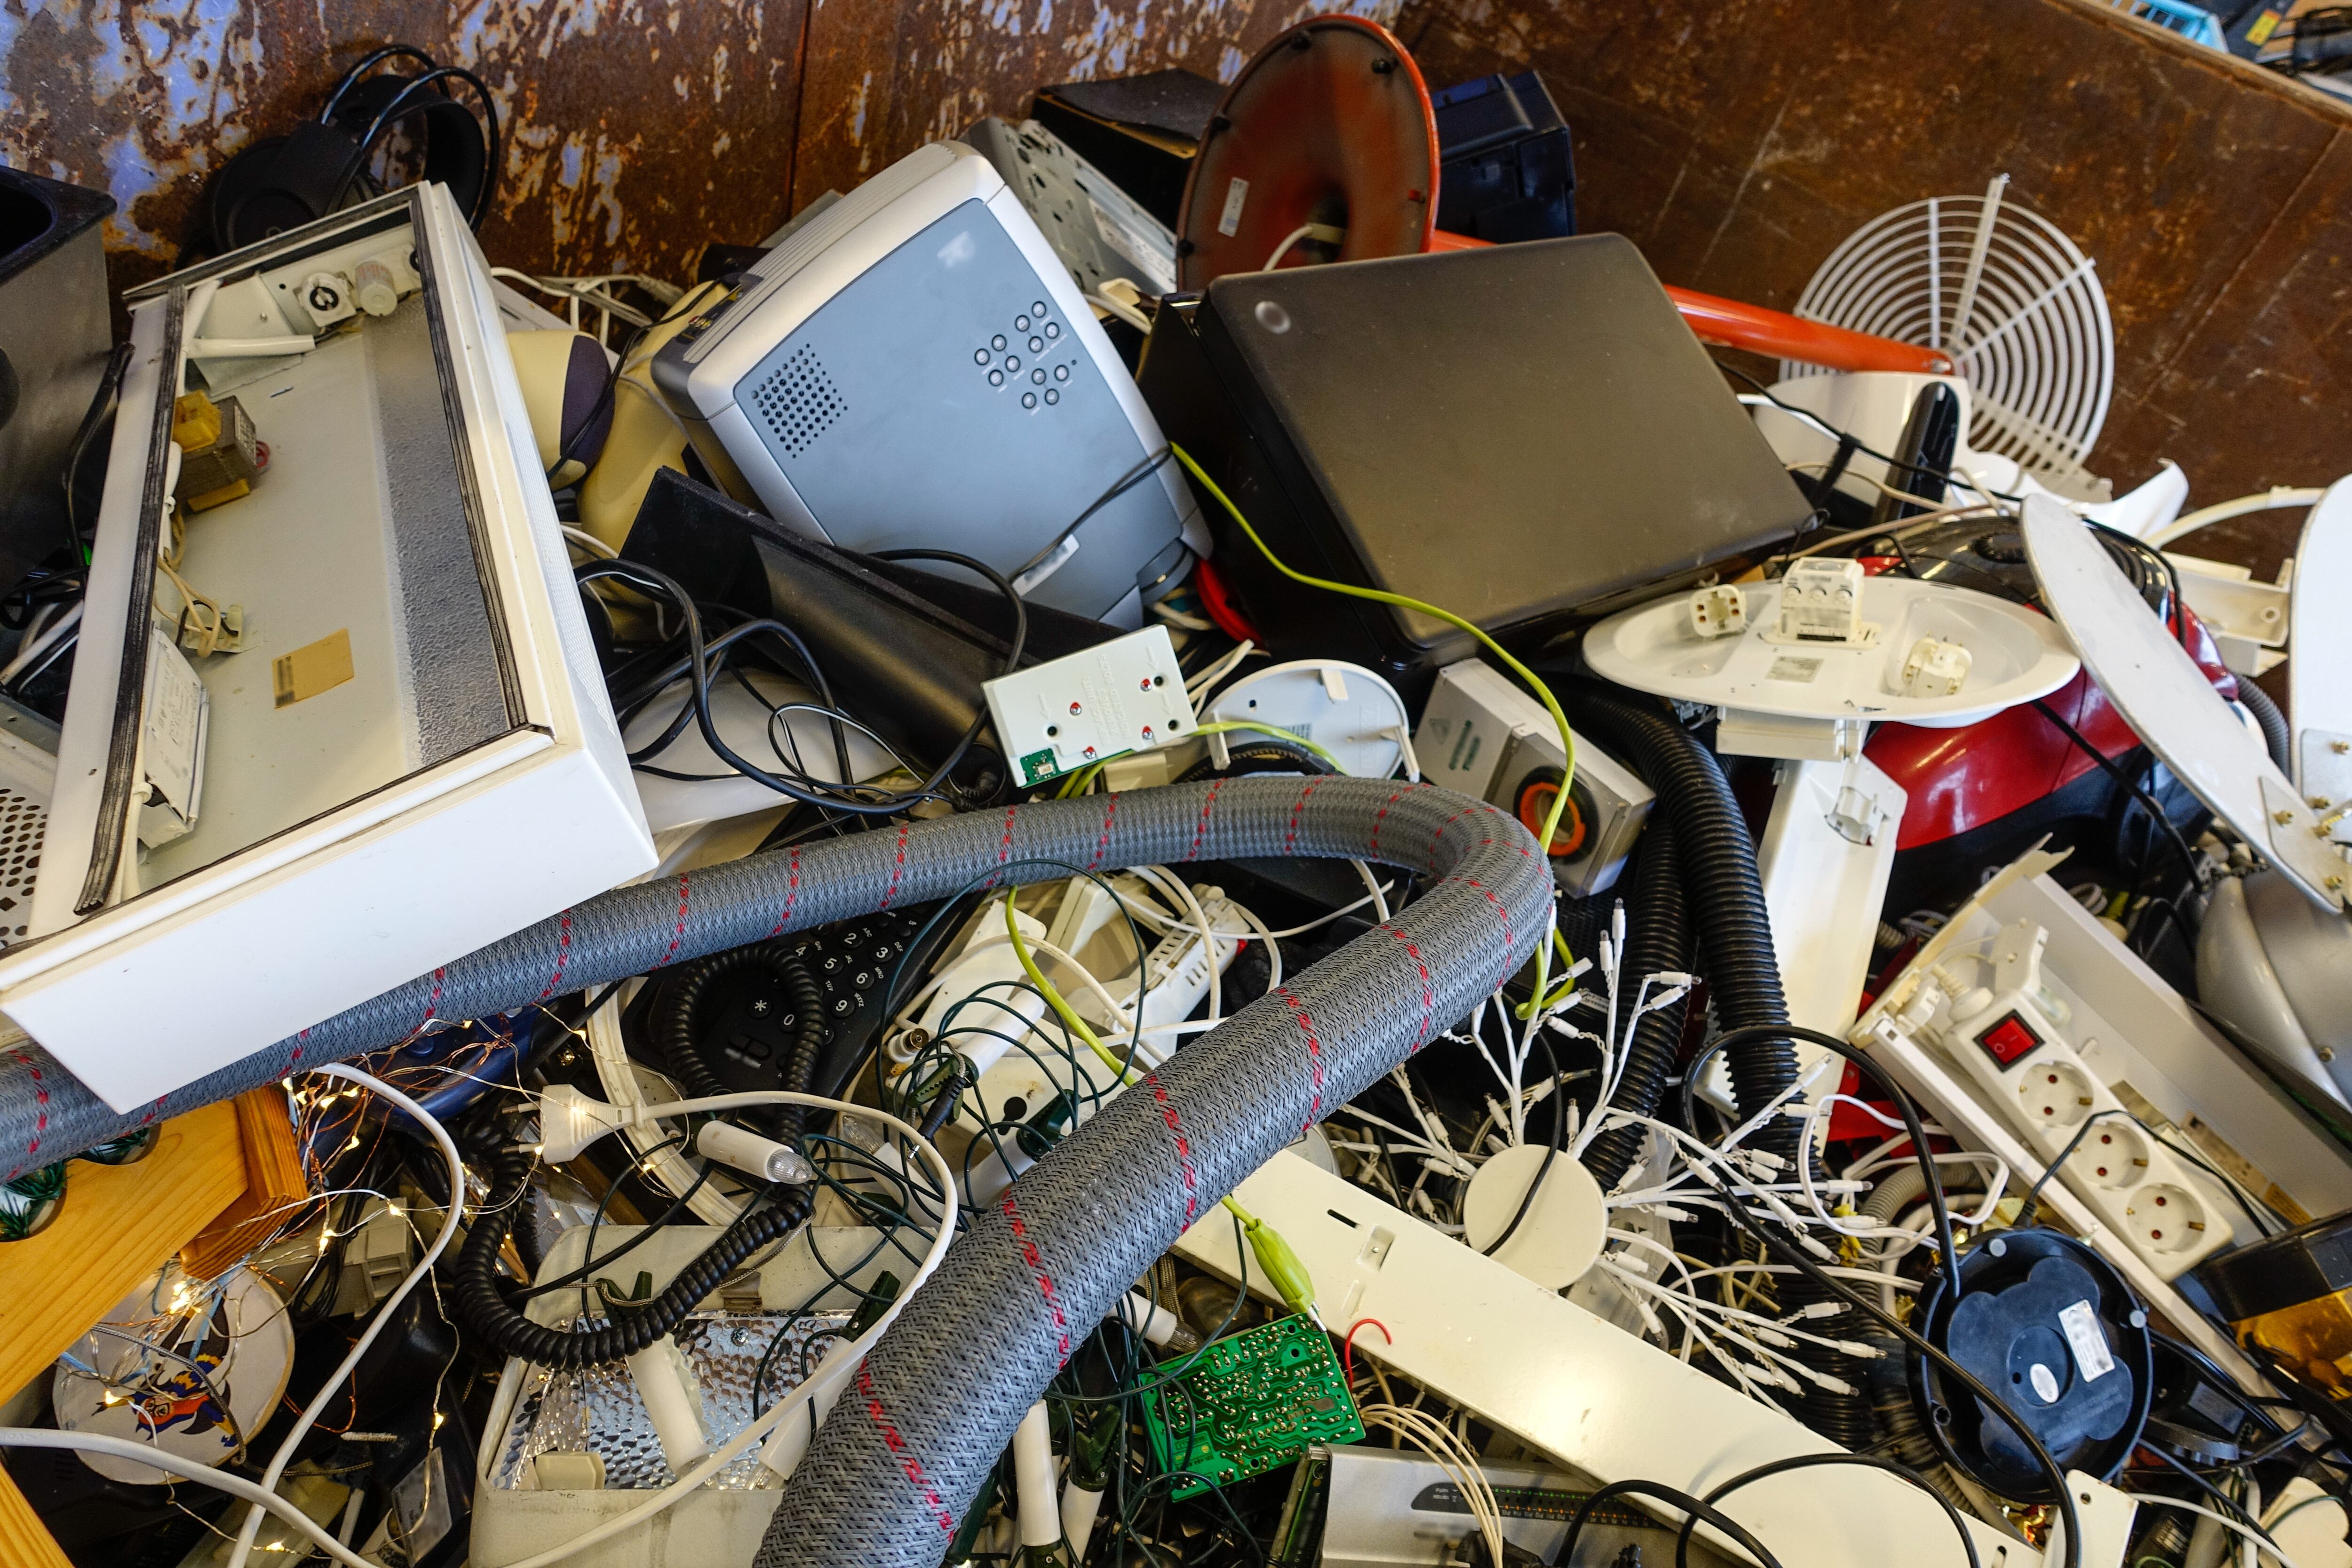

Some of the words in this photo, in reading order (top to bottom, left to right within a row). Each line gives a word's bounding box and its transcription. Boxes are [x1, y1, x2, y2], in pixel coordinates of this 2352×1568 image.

[844, 932, 857, 945] 2
[795, 946, 807, 957] 4
[894, 941, 903, 952] DEF
[876, 947, 889, 958] 3
[824, 957, 837, 969] 5
[856, 972, 868, 984] 6
[874, 967, 884, 979] MNO
[825, 980, 834, 991] TUV
[835, 1000, 848, 1011] 9
[783, 1014, 795, 1026] 0
